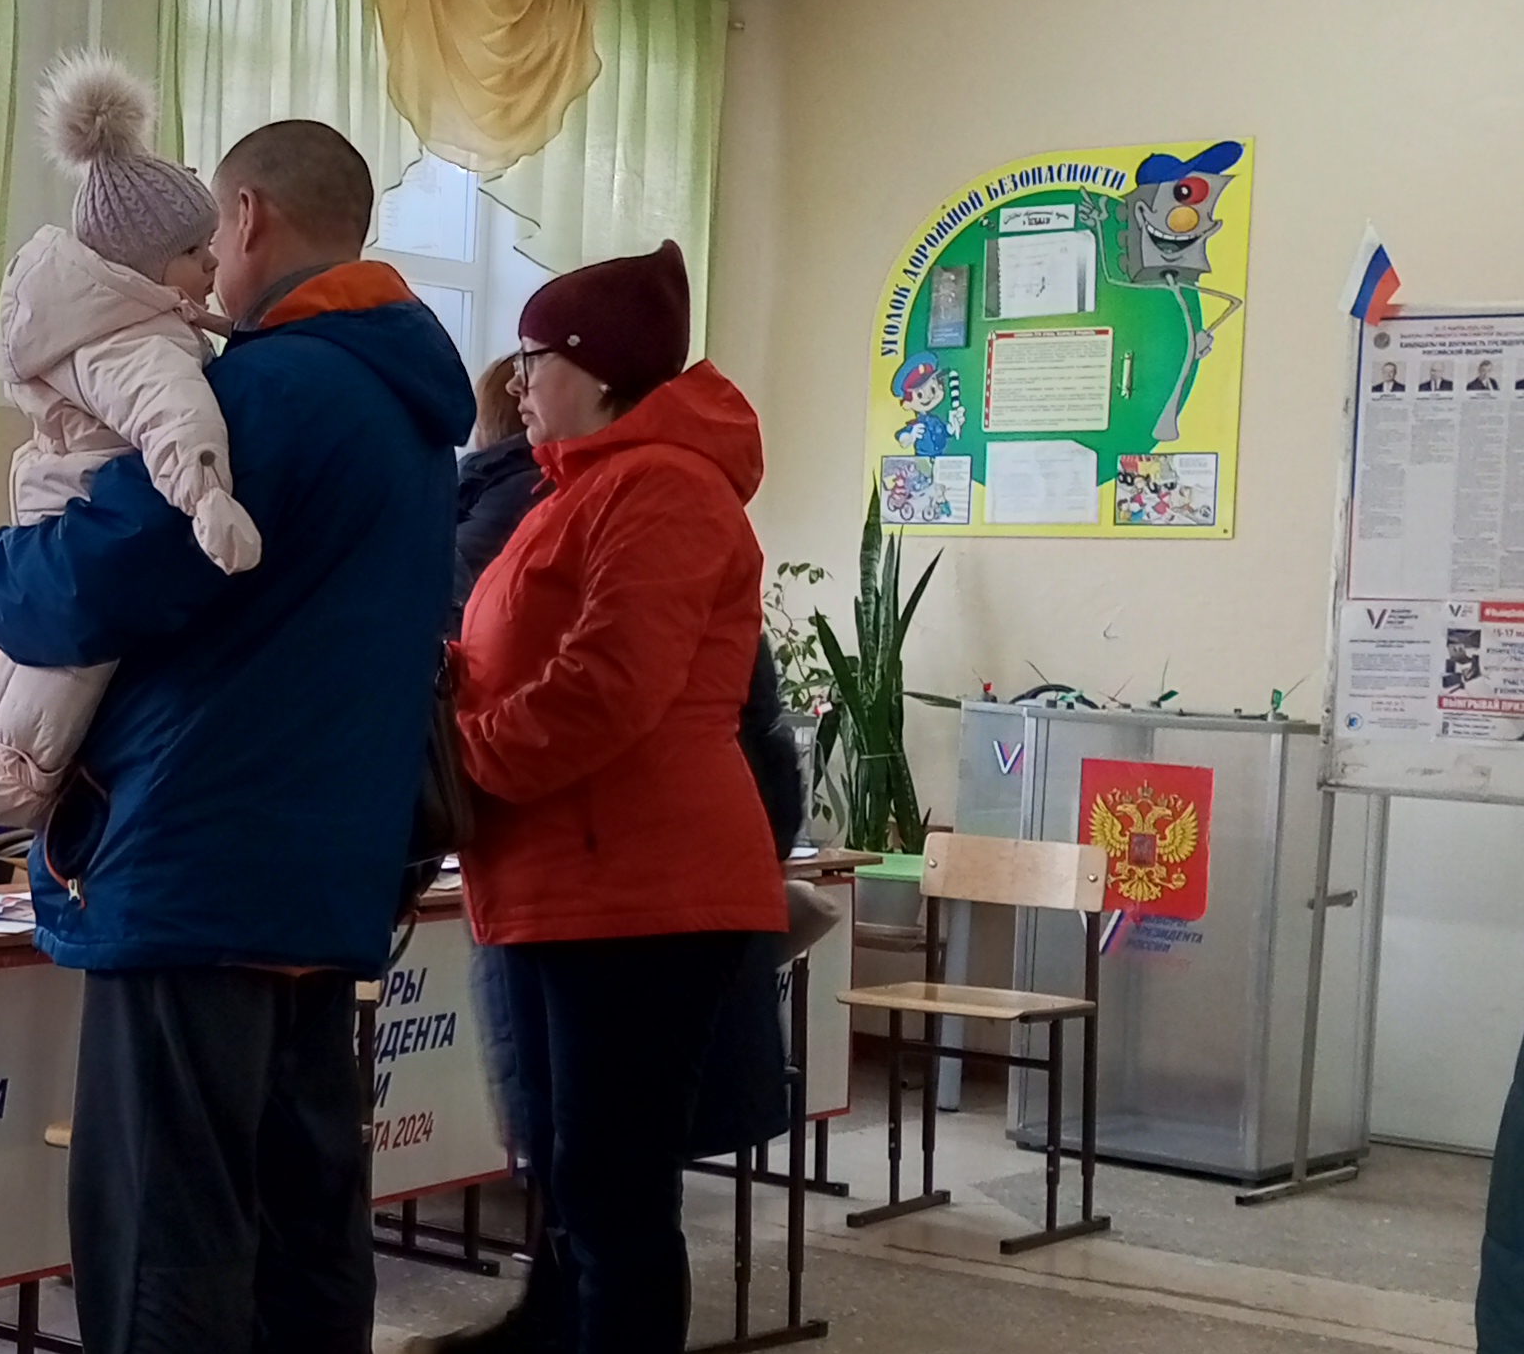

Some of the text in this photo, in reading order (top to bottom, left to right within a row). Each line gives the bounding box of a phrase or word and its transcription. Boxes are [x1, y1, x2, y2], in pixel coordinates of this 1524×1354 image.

[880, 163, 1127, 357] УГОЛОК ДОРОЖНОЙ БЕЗОПАСНОСТИ
[391, 1111, 435, 1150] 2024
